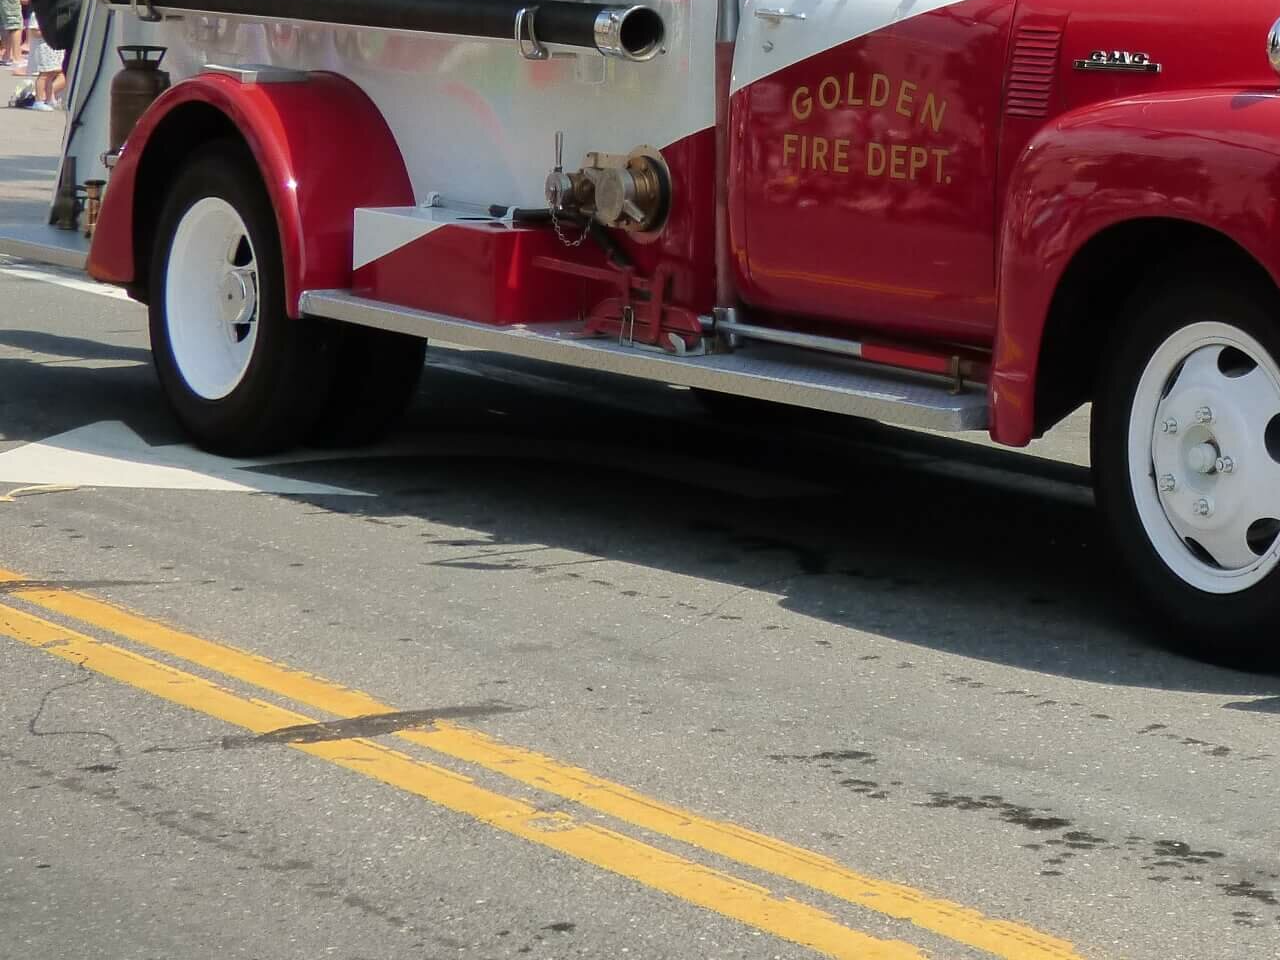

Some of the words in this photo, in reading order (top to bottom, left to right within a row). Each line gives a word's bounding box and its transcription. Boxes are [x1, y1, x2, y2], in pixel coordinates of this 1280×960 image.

[1089, 50, 1150, 65] GMC
[791, 72, 947, 132] GOLDEN
[783, 134, 850, 173] FIRE
[867, 141, 952, 184] DEPT.
